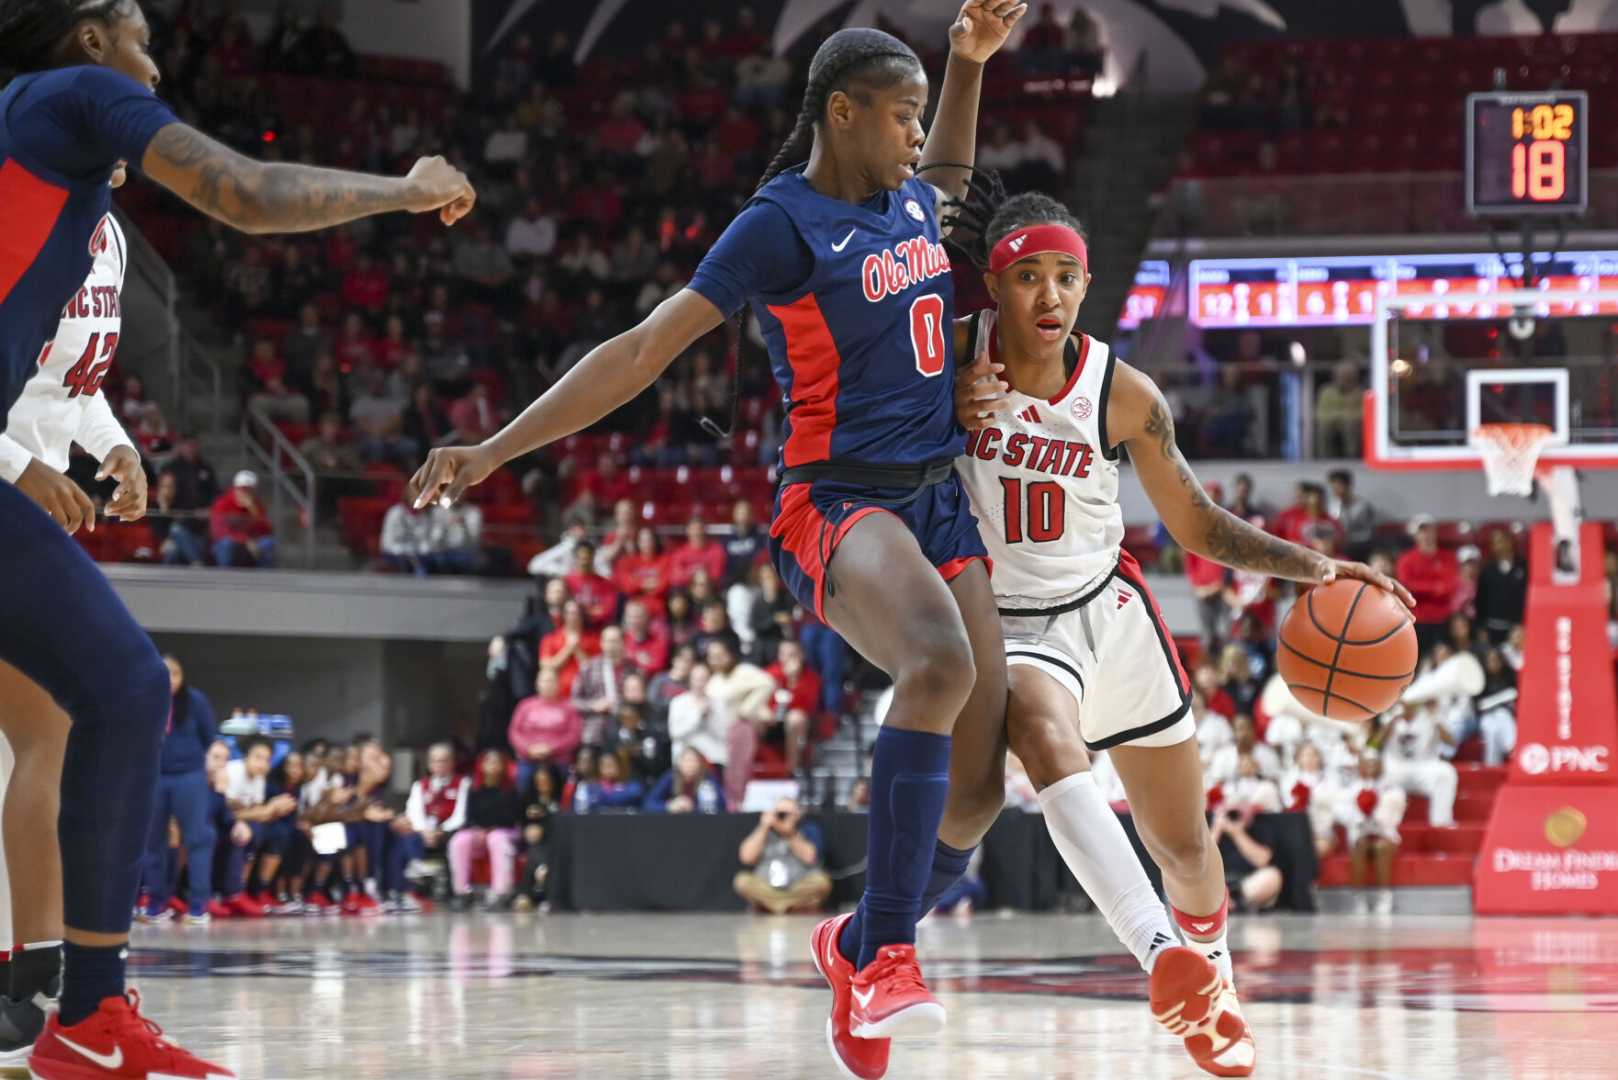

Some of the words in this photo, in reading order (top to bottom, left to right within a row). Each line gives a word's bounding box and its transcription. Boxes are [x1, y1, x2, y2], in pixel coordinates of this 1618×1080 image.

[1511, 103, 1575, 141] 1:02
[1510, 140, 1567, 201] 18
[862, 249, 909, 303] Ole
[909, 293, 946, 378] 0
[62, 332, 119, 398] 42
[1001, 432, 1094, 479] STATE
[998, 475, 1066, 544] 10
[1551, 745, 1610, 773] PNC
